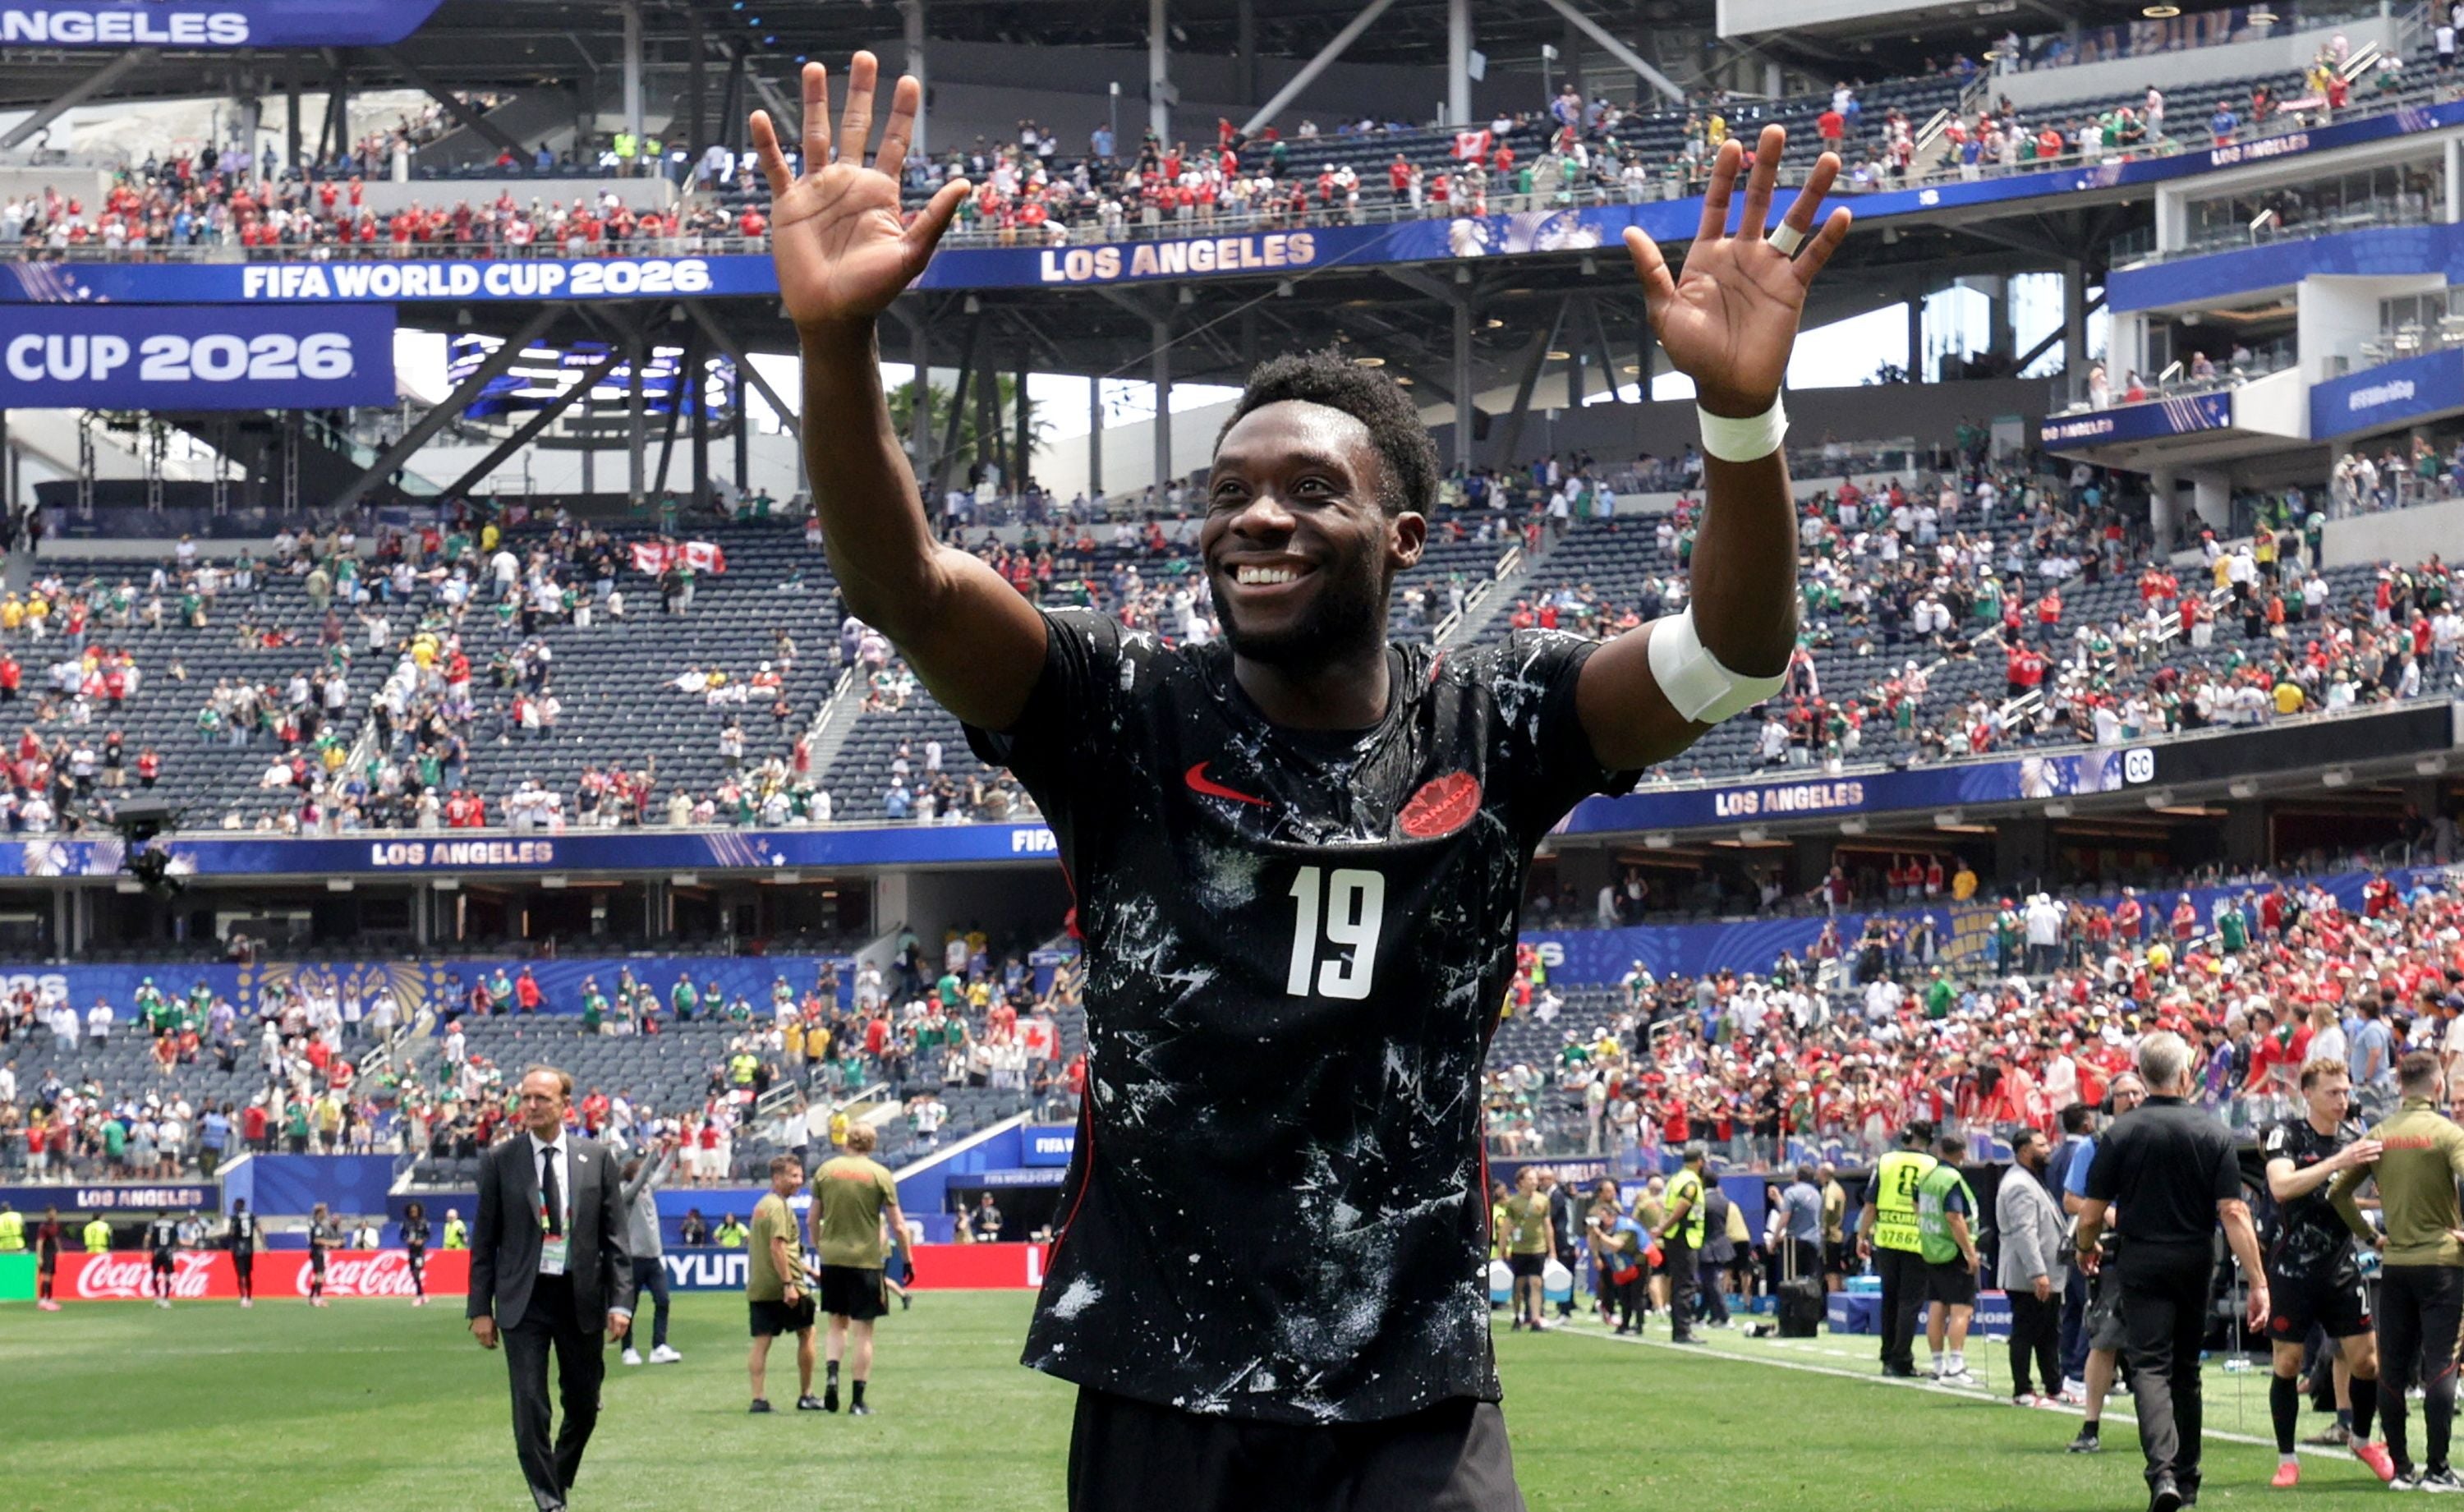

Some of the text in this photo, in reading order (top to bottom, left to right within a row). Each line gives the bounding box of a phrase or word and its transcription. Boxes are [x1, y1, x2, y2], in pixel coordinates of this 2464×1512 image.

[0, 11, 250, 44] NGELES
[1041, 233, 1314, 282] LOS ANGELES
[243, 260, 710, 298] FIFA WORLD CUP 2026
[6, 333, 355, 382] CUP 2026
[2129, 755, 2149, 777] CC
[1405, 784, 1473, 830] CANADA
[1716, 782, 1864, 816] LOS ANGELES
[372, 841, 554, 865] LOS ANGELES
[1286, 865, 1386, 1000] 19
[0, 973, 69, 1004] 26
[1036, 1137, 1065, 1154] FIFA
[77, 1188, 202, 1206] LOS ANGELES
